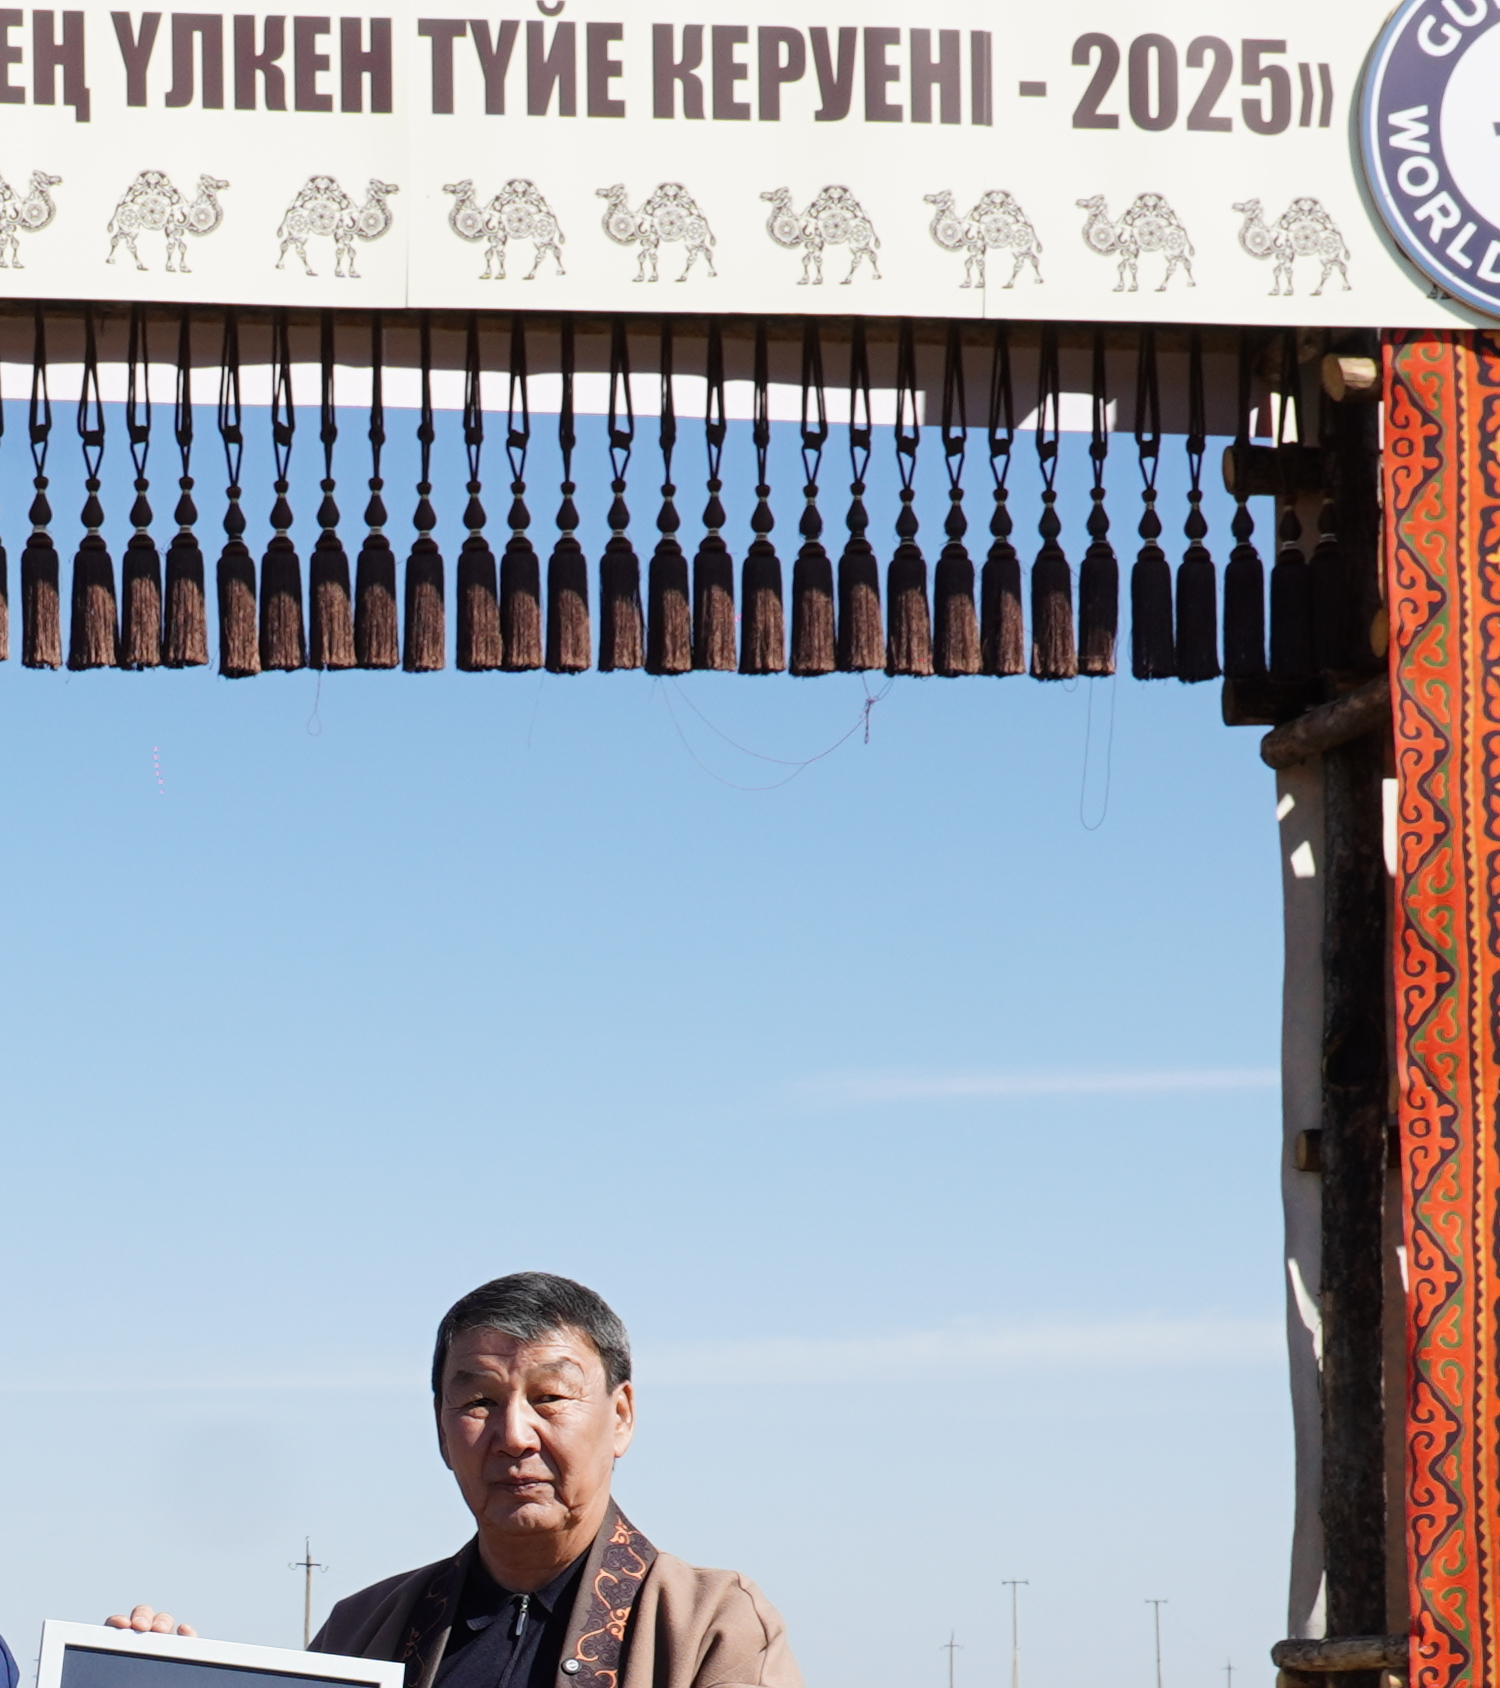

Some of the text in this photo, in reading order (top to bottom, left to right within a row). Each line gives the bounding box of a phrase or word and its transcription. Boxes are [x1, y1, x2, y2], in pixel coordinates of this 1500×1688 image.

[110, 11, 394, 114] ҮЛКЕН
[417, 0, 627, 119] ТҮЙЕ
[652, 22, 993, 127] КЕРУЕНІ
[1071, 31, 1335, 135] 2025»
